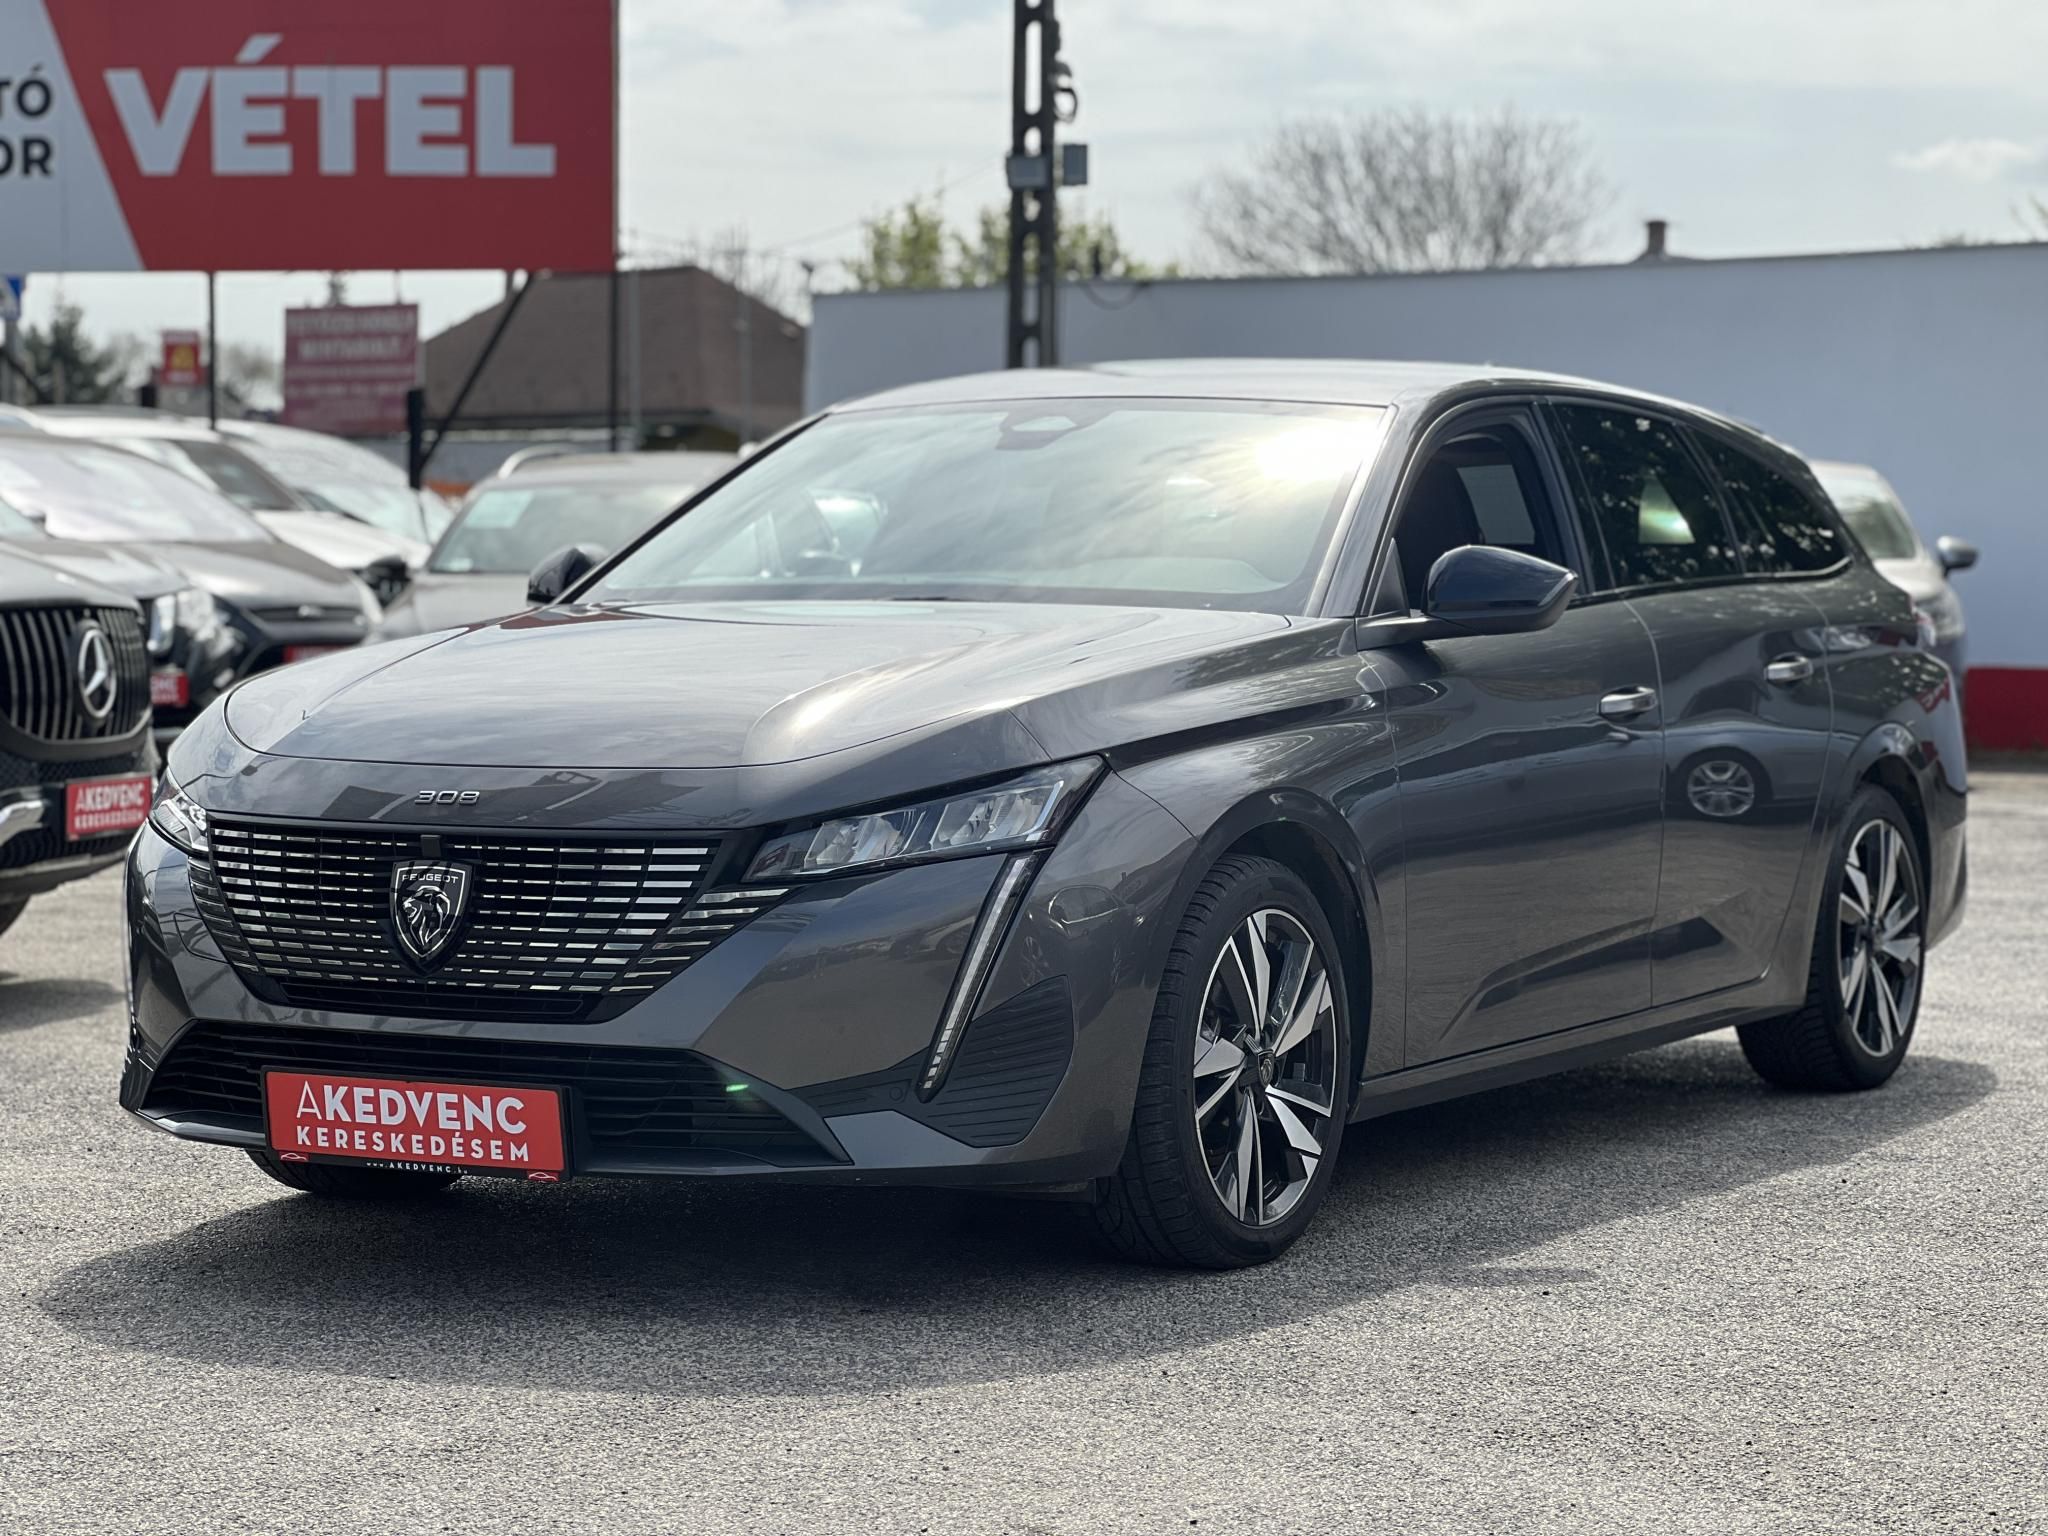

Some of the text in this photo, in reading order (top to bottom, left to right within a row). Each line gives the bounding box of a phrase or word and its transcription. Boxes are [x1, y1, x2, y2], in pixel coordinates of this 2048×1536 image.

[103, 33, 557, 176] VÉTEL
[74, 782, 145, 813] AKEDVENC
[414, 790, 480, 804] 308
[401, 873, 459, 884] PEUGEOT
[295, 1080, 528, 1135] AKEDVENC
[296, 1125, 529, 1162] KERESKEDÉSEM
